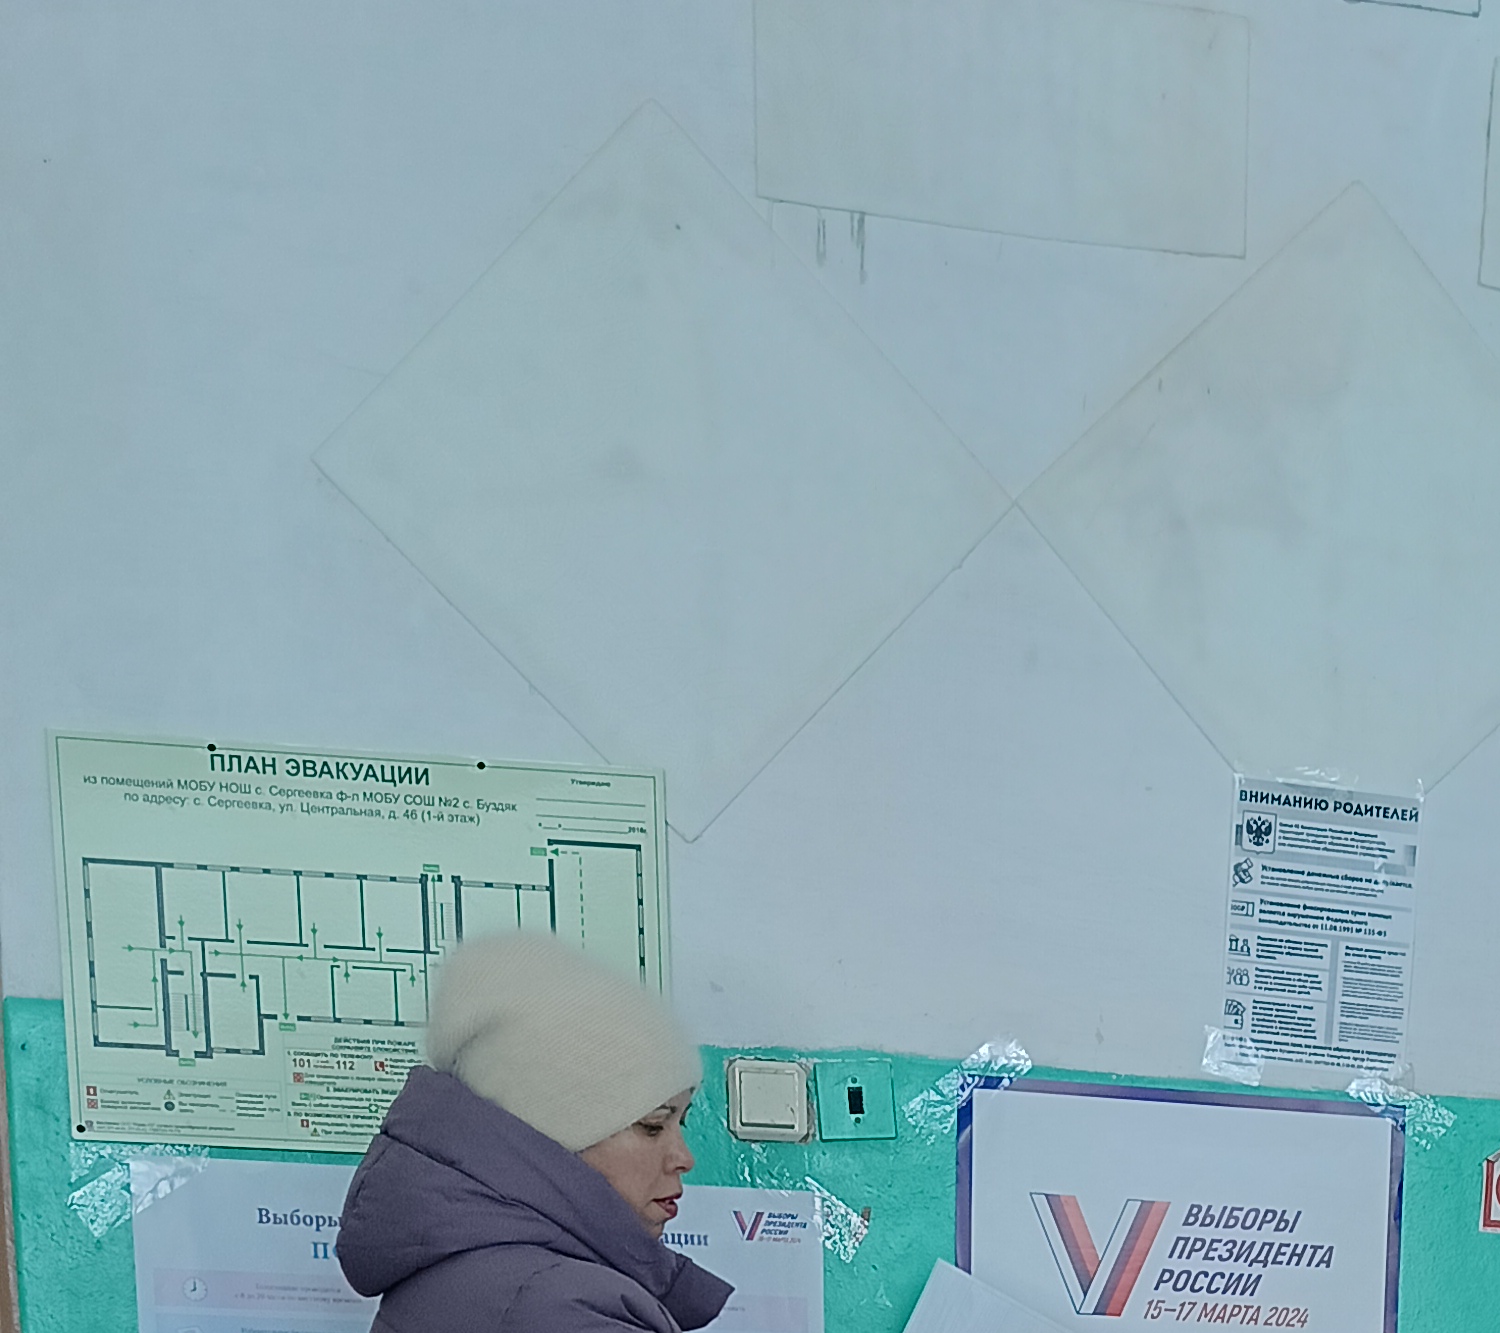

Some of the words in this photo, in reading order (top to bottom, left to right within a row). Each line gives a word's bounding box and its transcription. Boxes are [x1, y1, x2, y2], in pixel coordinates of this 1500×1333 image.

[210, 754, 277, 776] ПЛАН
[285, 758, 430, 787] ЭВАКУАЦИИ
[83, 775, 97, 784] из
[101, 777, 174, 789] помещений
[177, 780, 215, 792] МОБУ
[219, 782, 252, 795] НОШ
[269, 785, 333, 800] Сергеевка
[363, 792, 400, 804] МОБУ
[404, 794, 435, 807] СОШ
[439, 796, 459, 808] №2
[476, 799, 517, 812] Буздяк
[1240, 790, 1329, 811] ВНИМАНИЮ
[1334, 801, 1419, 822] РОДИТЕЛЕЙ
[124, 793, 139, 802] по
[207, 796, 275, 811] Сергеевка,
[279, 803, 296, 814] ул.
[300, 804, 385, 819] Центральная,
[387, 811, 399, 819] д.
[403, 810, 418, 820] 46
[421, 811, 444, 822] (1-й
[448, 813, 481, 826] этаж)
[292, 1058, 311, 1068] 101
[335, 1060, 355, 1071] 112
[257, 1208, 341, 1231] Выборы
[1182, 1203, 1302, 1234] ВЫБОРЫ
[1168, 1236, 1334, 1270] ПРЕЗИДЕНТА
[1154, 1268, 1263, 1297] РОССИИ
[1198, 1302, 1263, 1327] МАРТА
[1264, 1305, 1310, 1329] 2024
